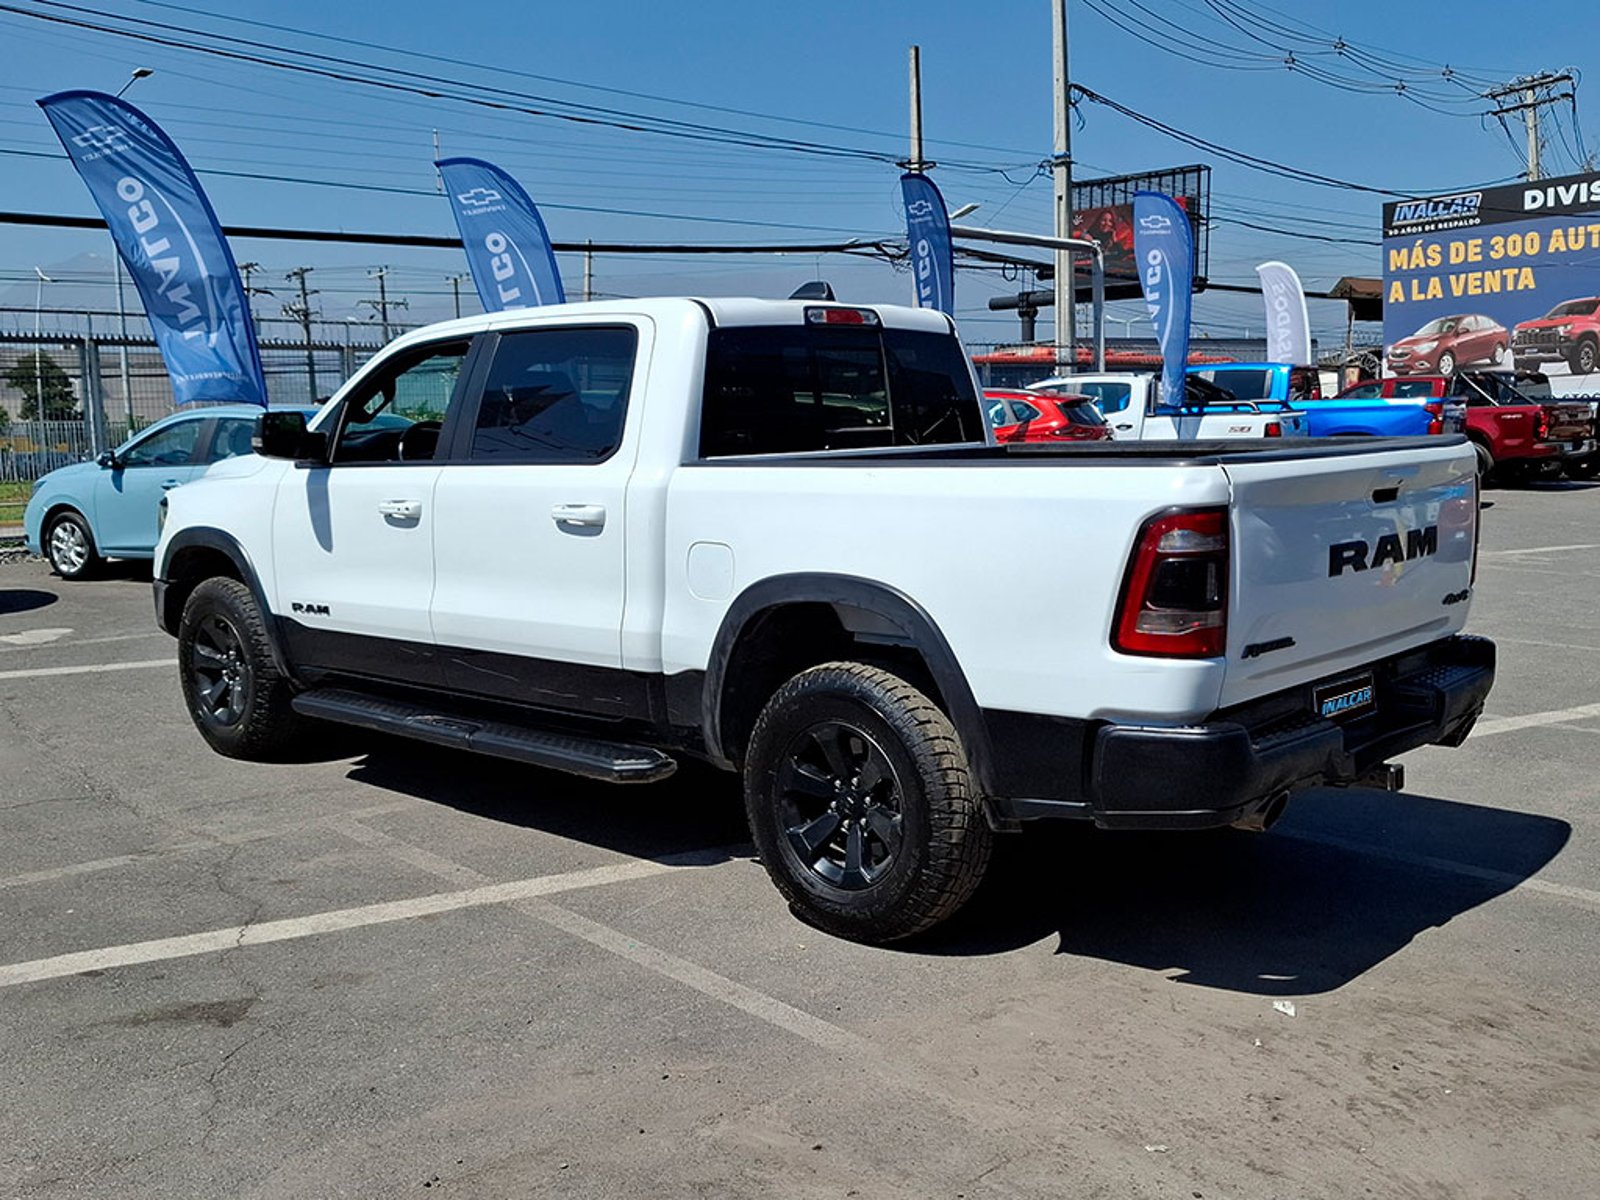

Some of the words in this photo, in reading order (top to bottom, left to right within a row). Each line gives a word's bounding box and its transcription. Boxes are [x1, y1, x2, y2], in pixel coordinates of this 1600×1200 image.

[1393, 195, 1478, 221] INALCAR
[1424, 224, 1436, 233] DE
[1437, 217, 1481, 231] RESPALDO
[1389, 239, 1442, 272] MÁS
[1449, 239, 1483, 265] DE
[1490, 231, 1541, 260] 300
[1388, 281, 1405, 304] A
[1412, 277, 1443, 301] LA
[1449, 267, 1536, 297] VENTA
[1328, 526, 1438, 578] RAM
[291, 602, 330, 617] RAM
[1321, 687, 1372, 715] INALCAR
